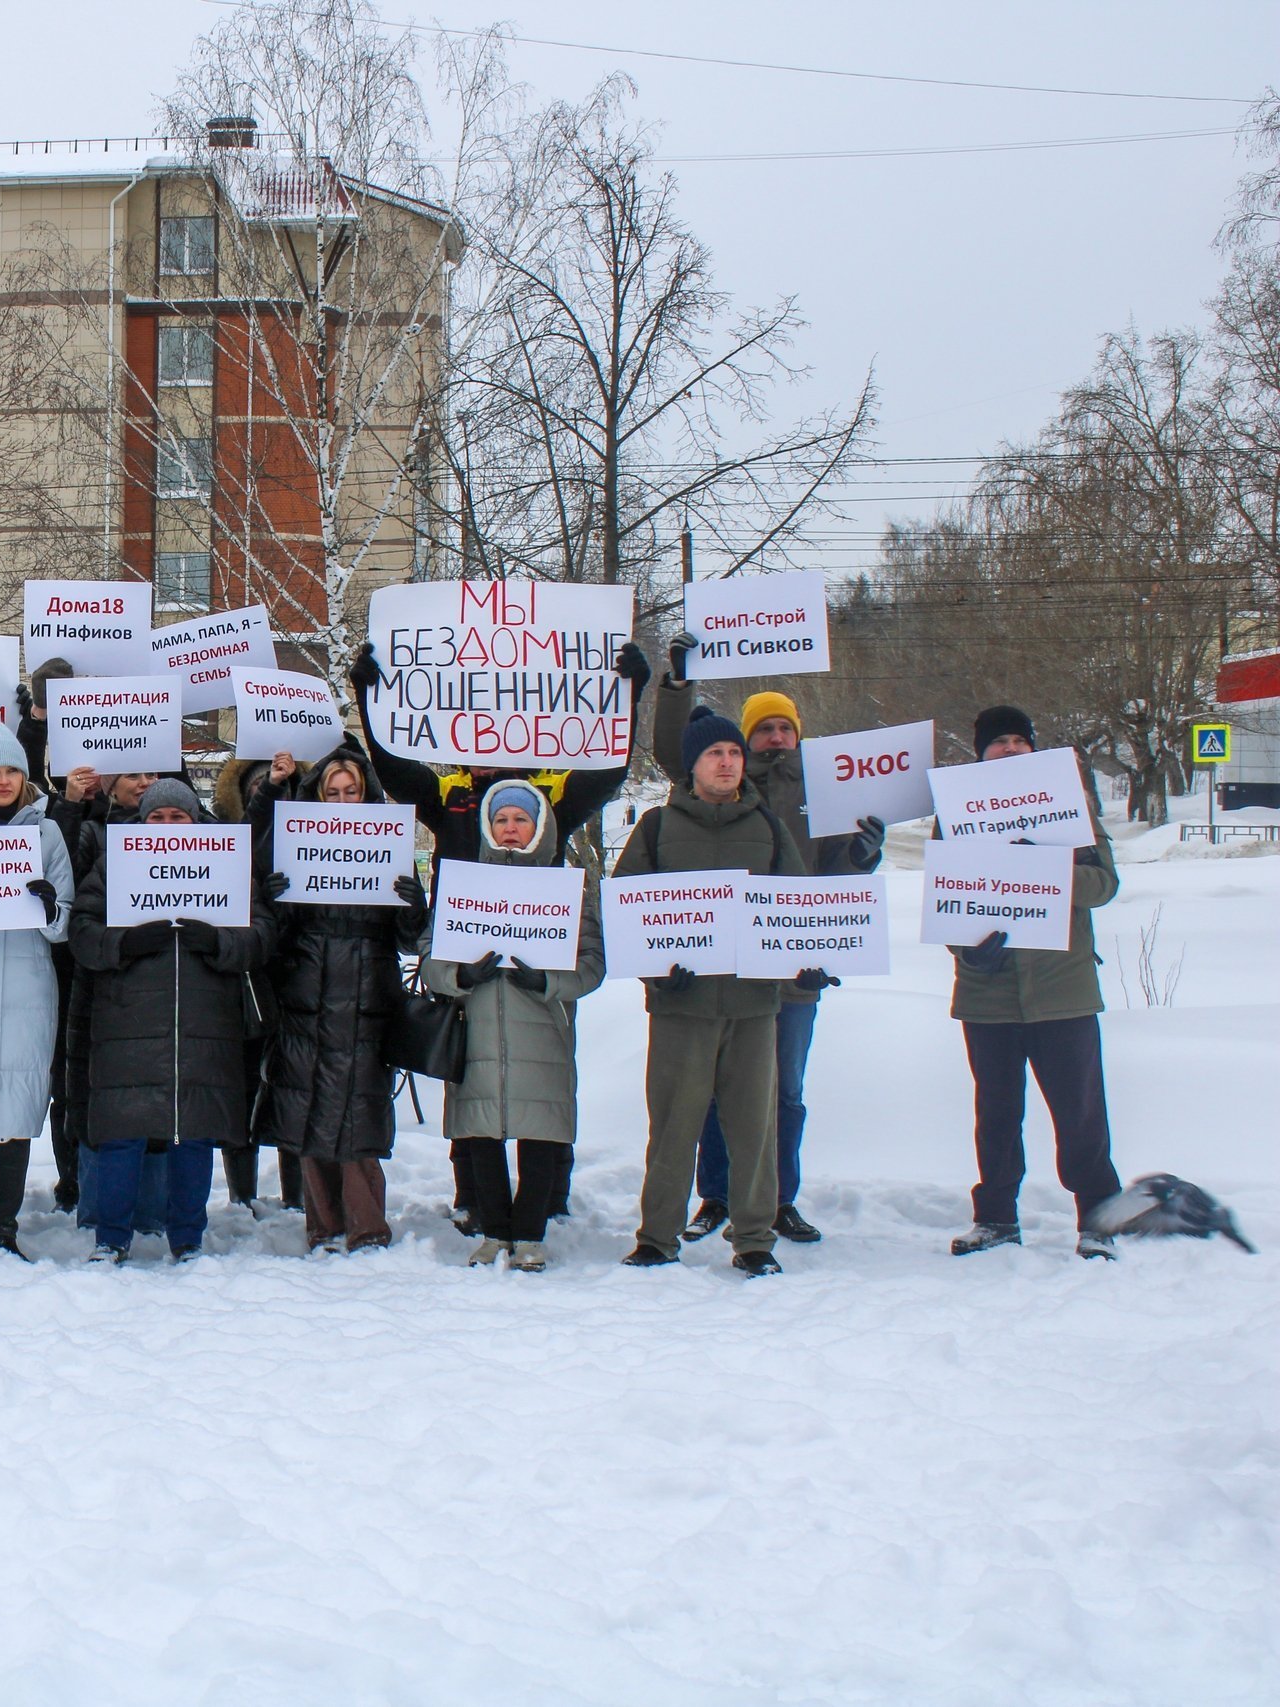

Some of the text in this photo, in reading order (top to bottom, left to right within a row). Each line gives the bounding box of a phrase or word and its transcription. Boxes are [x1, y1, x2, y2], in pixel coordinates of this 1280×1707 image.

[47, 597, 124, 616] Дома18
[460, 580, 535, 625] МЫ
[704, 608, 806, 631] СНиП-Строй
[30, 624, 133, 641] ИП Нафиков
[152, 631, 196, 651] МАМА,
[198, 623, 240, 641] ПАПА,
[242, 619, 251, 630] Я
[168, 641, 250, 668] БЕЗДОМНАЯ
[390, 626, 627, 670] БЕЗДОМНЫЕ
[701, 638, 813, 659] ИП Сивков
[59, 691, 170, 706] АККРЕДИТАЦИЯ
[245, 681, 329, 703] Стройресурс
[374, 667, 620, 714] МОШЕННИКИ
[61, 715, 157, 731] ПОДРЯДЧИКА
[255, 708, 332, 728] ИП Бобров
[82, 737, 147, 752] ФИКЦИЯ!
[390, 712, 628, 758] НА СВОБОДЕ
[834, 751, 910, 782] Экос
[966, 790, 1054, 814] СК Восход,
[286, 817, 404, 837] СТРОЙРЕСУРС
[951, 808, 1078, 837] ИП Гарифуллин
[123, 837, 236, 853] БЕЗДОМНЫЕ
[296, 847, 391, 863] ПРИСВОИЛ
[149, 865, 210, 880] СЕМЬИ
[306, 876, 379, 892] ДЕНЬГИ!
[935, 876, 1061, 896] Новый Уровень
[130, 893, 228, 910] УДМУРТИИ
[619, 884, 734, 905] МАТЕРИНСКИЙ
[745, 891, 877, 907] МЫ БЕЗДОМНЫЕ,
[447, 896, 570, 917] ЧЕРНЫЙ СПИСОК
[936, 899, 1046, 921] ИП Башорин
[642, 911, 714, 926] КАПИТАЛ
[752, 914, 871, 928] А МОШЕННИКИ
[446, 919, 567, 941] ЗАСТРОЙЩИКОВ
[647, 935, 713, 950] УКРАЛИ!
[761, 936, 862, 951] НА СВОБОДЕ!
